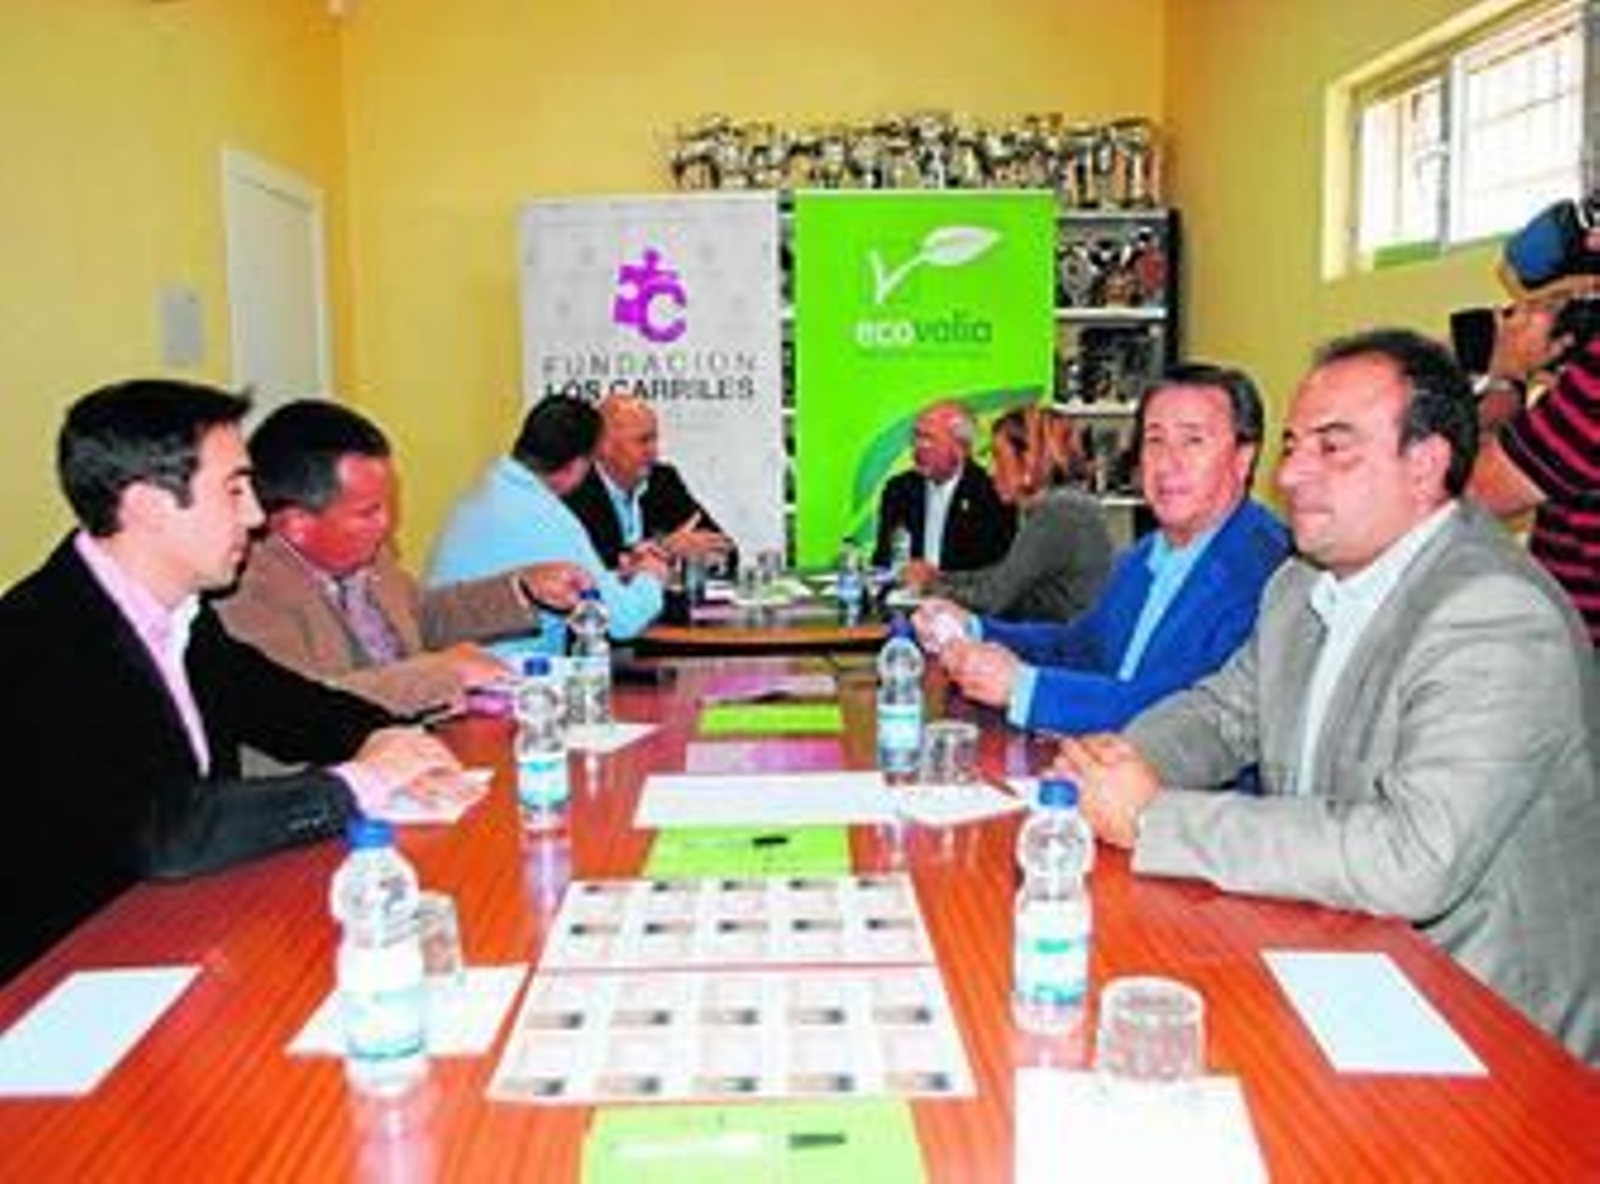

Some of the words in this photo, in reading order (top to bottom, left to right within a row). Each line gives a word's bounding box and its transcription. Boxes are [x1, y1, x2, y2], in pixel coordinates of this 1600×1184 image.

[855, 313, 992, 344] ecovalia
[545, 378, 600, 400] LOS
[609, 377, 755, 400] CARRILES
